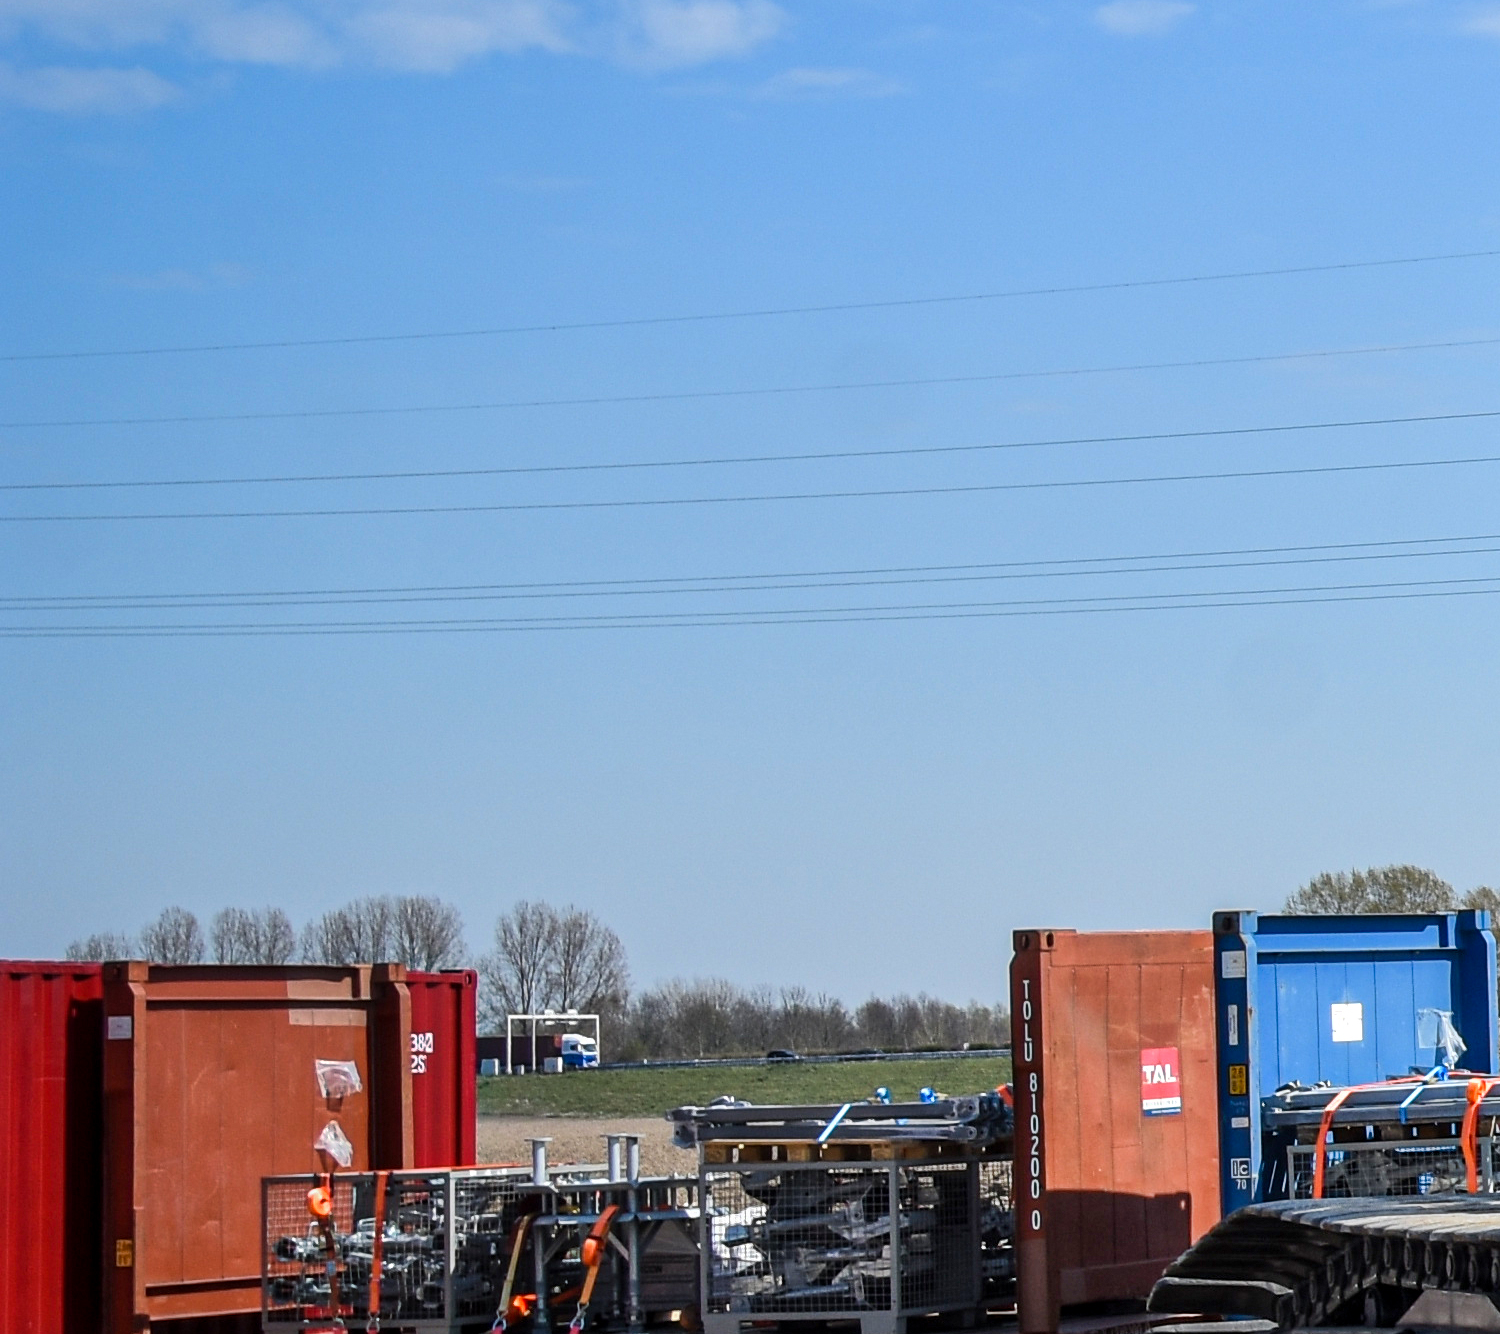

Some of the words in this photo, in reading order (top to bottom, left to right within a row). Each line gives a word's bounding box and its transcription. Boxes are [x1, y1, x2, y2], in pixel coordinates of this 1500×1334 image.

[1022, 980, 1033, 1062] TOLU
[1029, 1072, 1040, 1199] 810200
[1142, 1063, 1177, 1084] TAL
